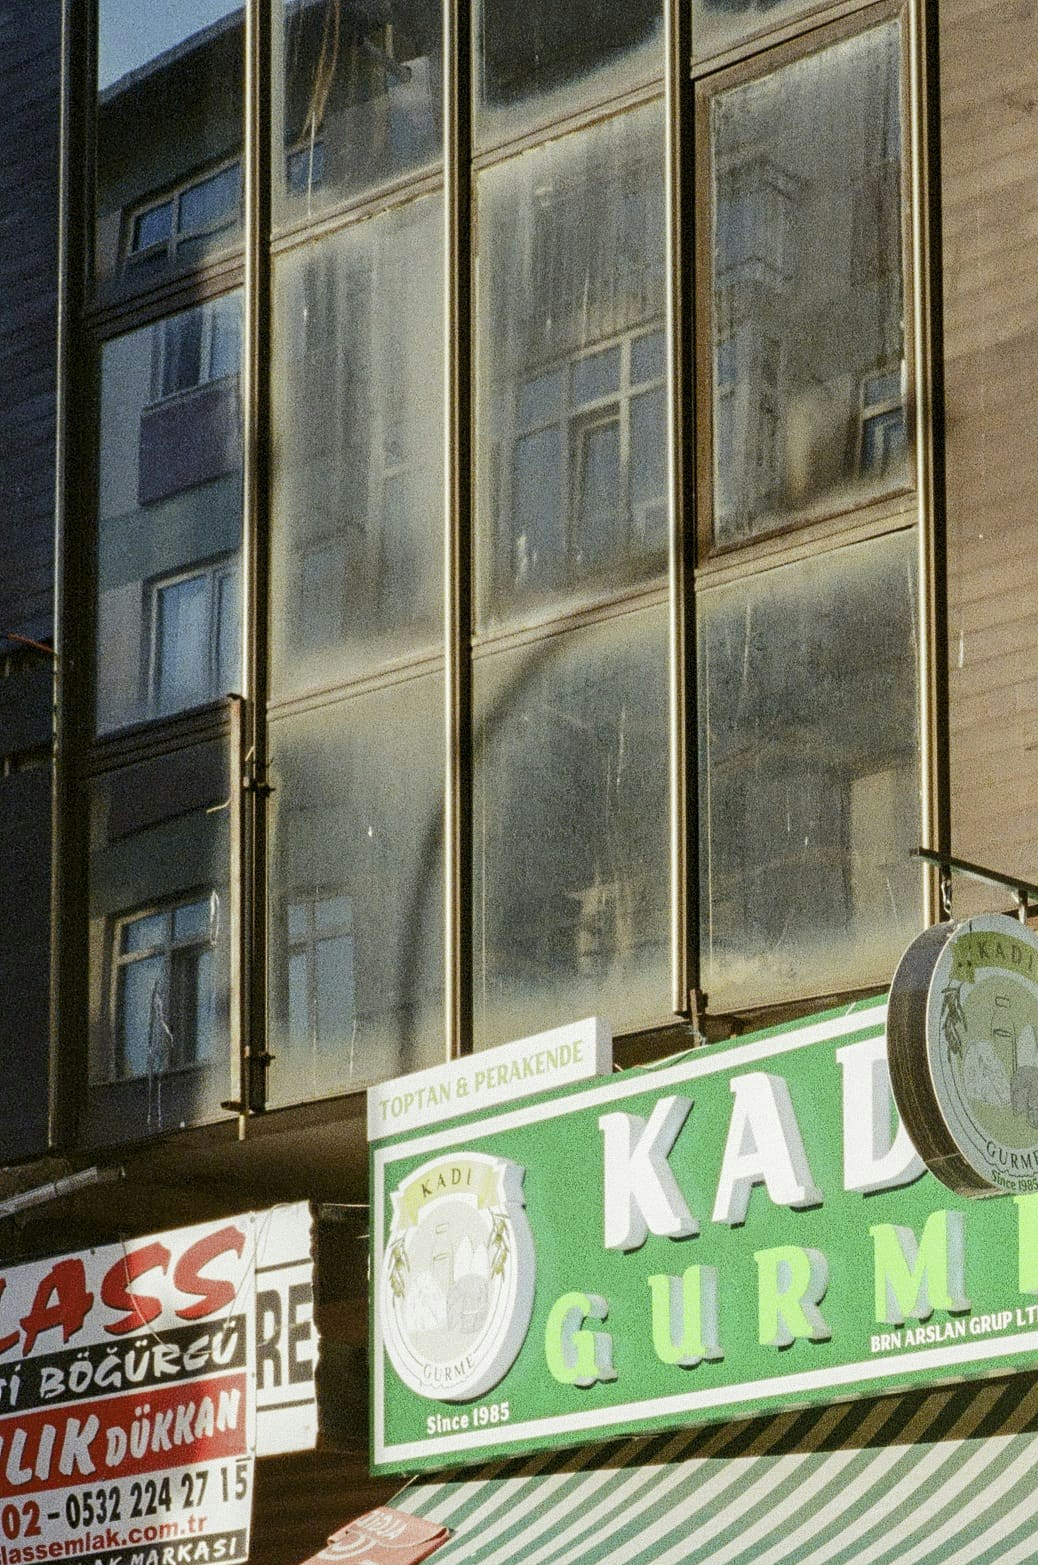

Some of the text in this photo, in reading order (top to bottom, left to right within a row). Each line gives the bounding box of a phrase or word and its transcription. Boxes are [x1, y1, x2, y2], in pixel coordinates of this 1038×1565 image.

[979, 940, 1034, 969] KADI
[378, 1085, 452, 1121] TOPTAN
[474, 1039, 583, 1095] PERAKENDE
[598, 1035, 930, 1252] KAD
[421, 1167, 472, 1198] KADI
[991, 1169, 1038, 1191] Since 1985
[870, 1326, 901, 1352] BRN
[905, 1317, 966, 1347] ARSLAN
[970, 1311, 1013, 1338] GRUP
[423, 1355, 476, 1382] GURME
[427, 1402, 510, 1435] Since 1985
[0, 1388, 239, 1487] LIK DÜKKAN
[130, 1477, 171, 1517] 224
[181, 1471, 208, 1507] 27
[220, 1464, 248, 1501] 15
